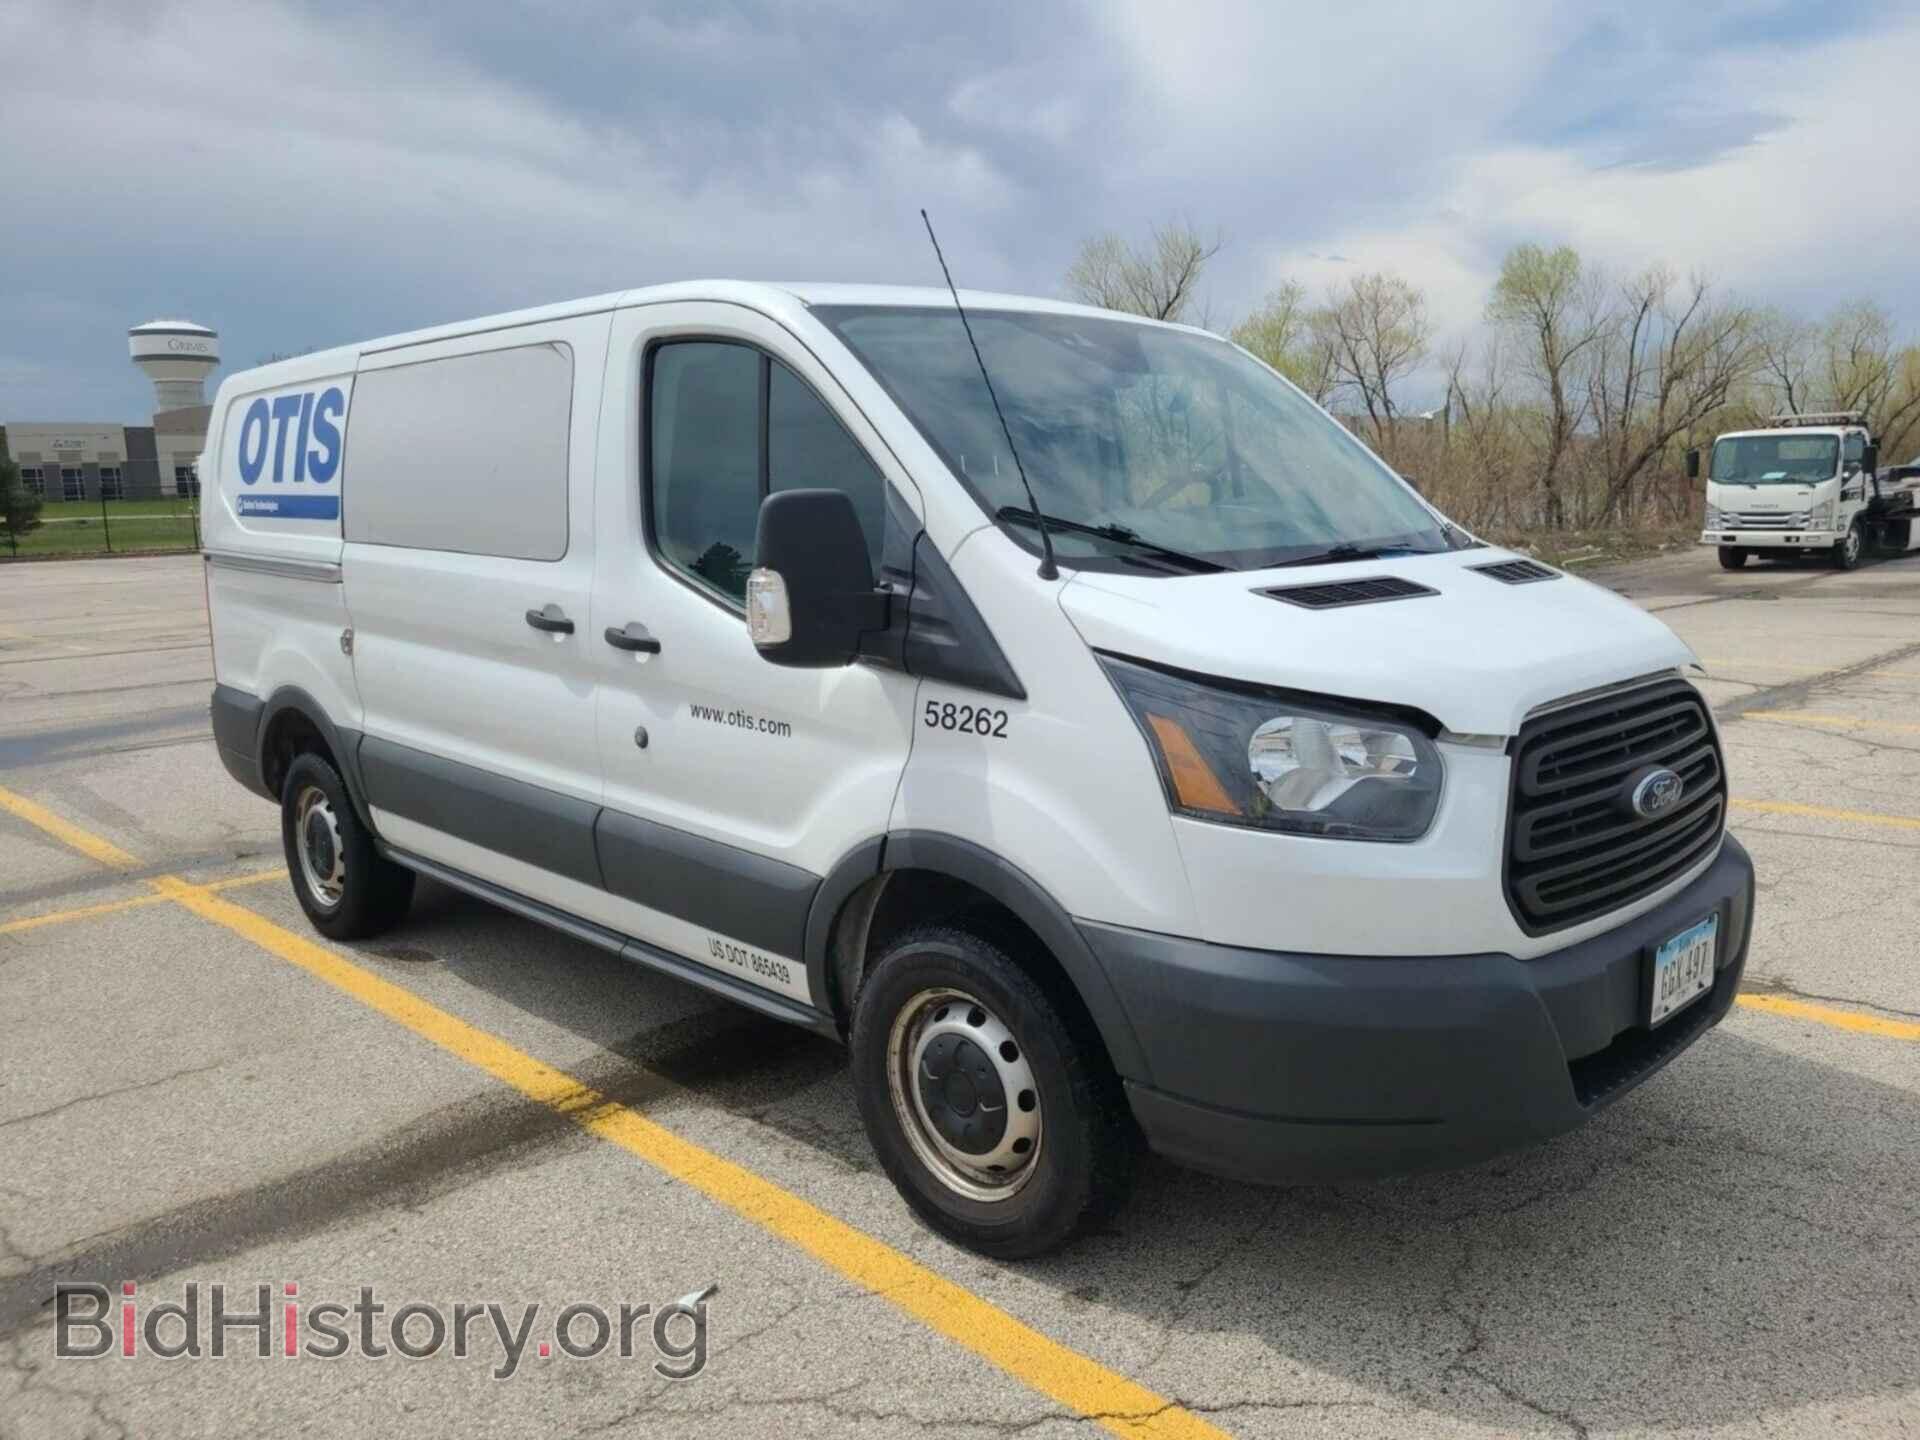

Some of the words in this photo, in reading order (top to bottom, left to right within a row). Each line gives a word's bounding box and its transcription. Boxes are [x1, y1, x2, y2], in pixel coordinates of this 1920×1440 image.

[238, 387, 344, 485] OTIS
[690, 703, 791, 737] www.otis.com
[924, 700, 1008, 738] 58262
[707, 936, 725, 959] US
[725, 943, 749, 969] DOT
[750, 953, 791, 984] 865439
